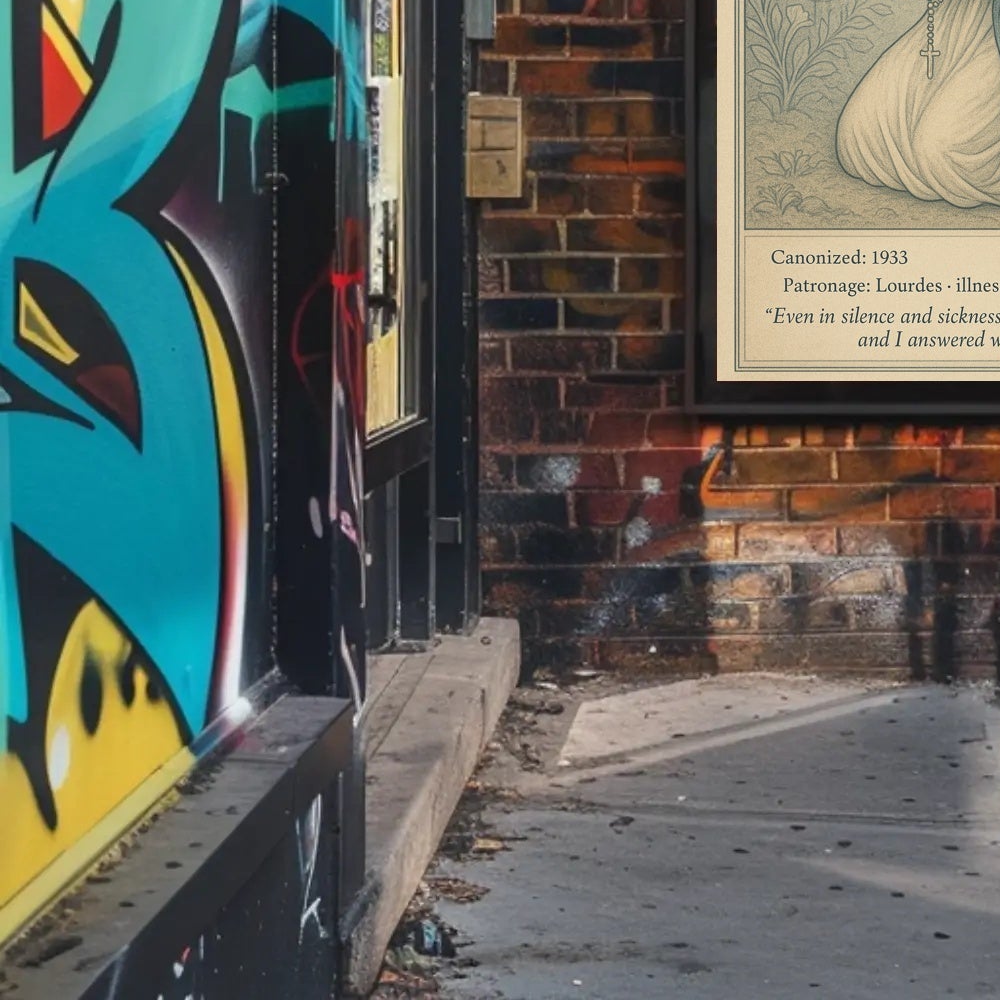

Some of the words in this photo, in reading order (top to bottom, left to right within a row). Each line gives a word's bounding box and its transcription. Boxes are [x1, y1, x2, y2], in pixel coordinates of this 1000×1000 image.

[770, 248, 867, 265] Canonized:
[871, 249, 908, 265] 1933
[783, 277, 871, 297] Patronage:
[875, 276, 943, 293] Lourdes
[765, 306, 814, 324] “Even
[819, 307, 835, 324] in
[841, 305, 895, 324] silence
[900, 305, 933, 324] and
[857, 329, 891, 347] and
[895, 330, 903, 347] I
[907, 329, 986, 348] answered
